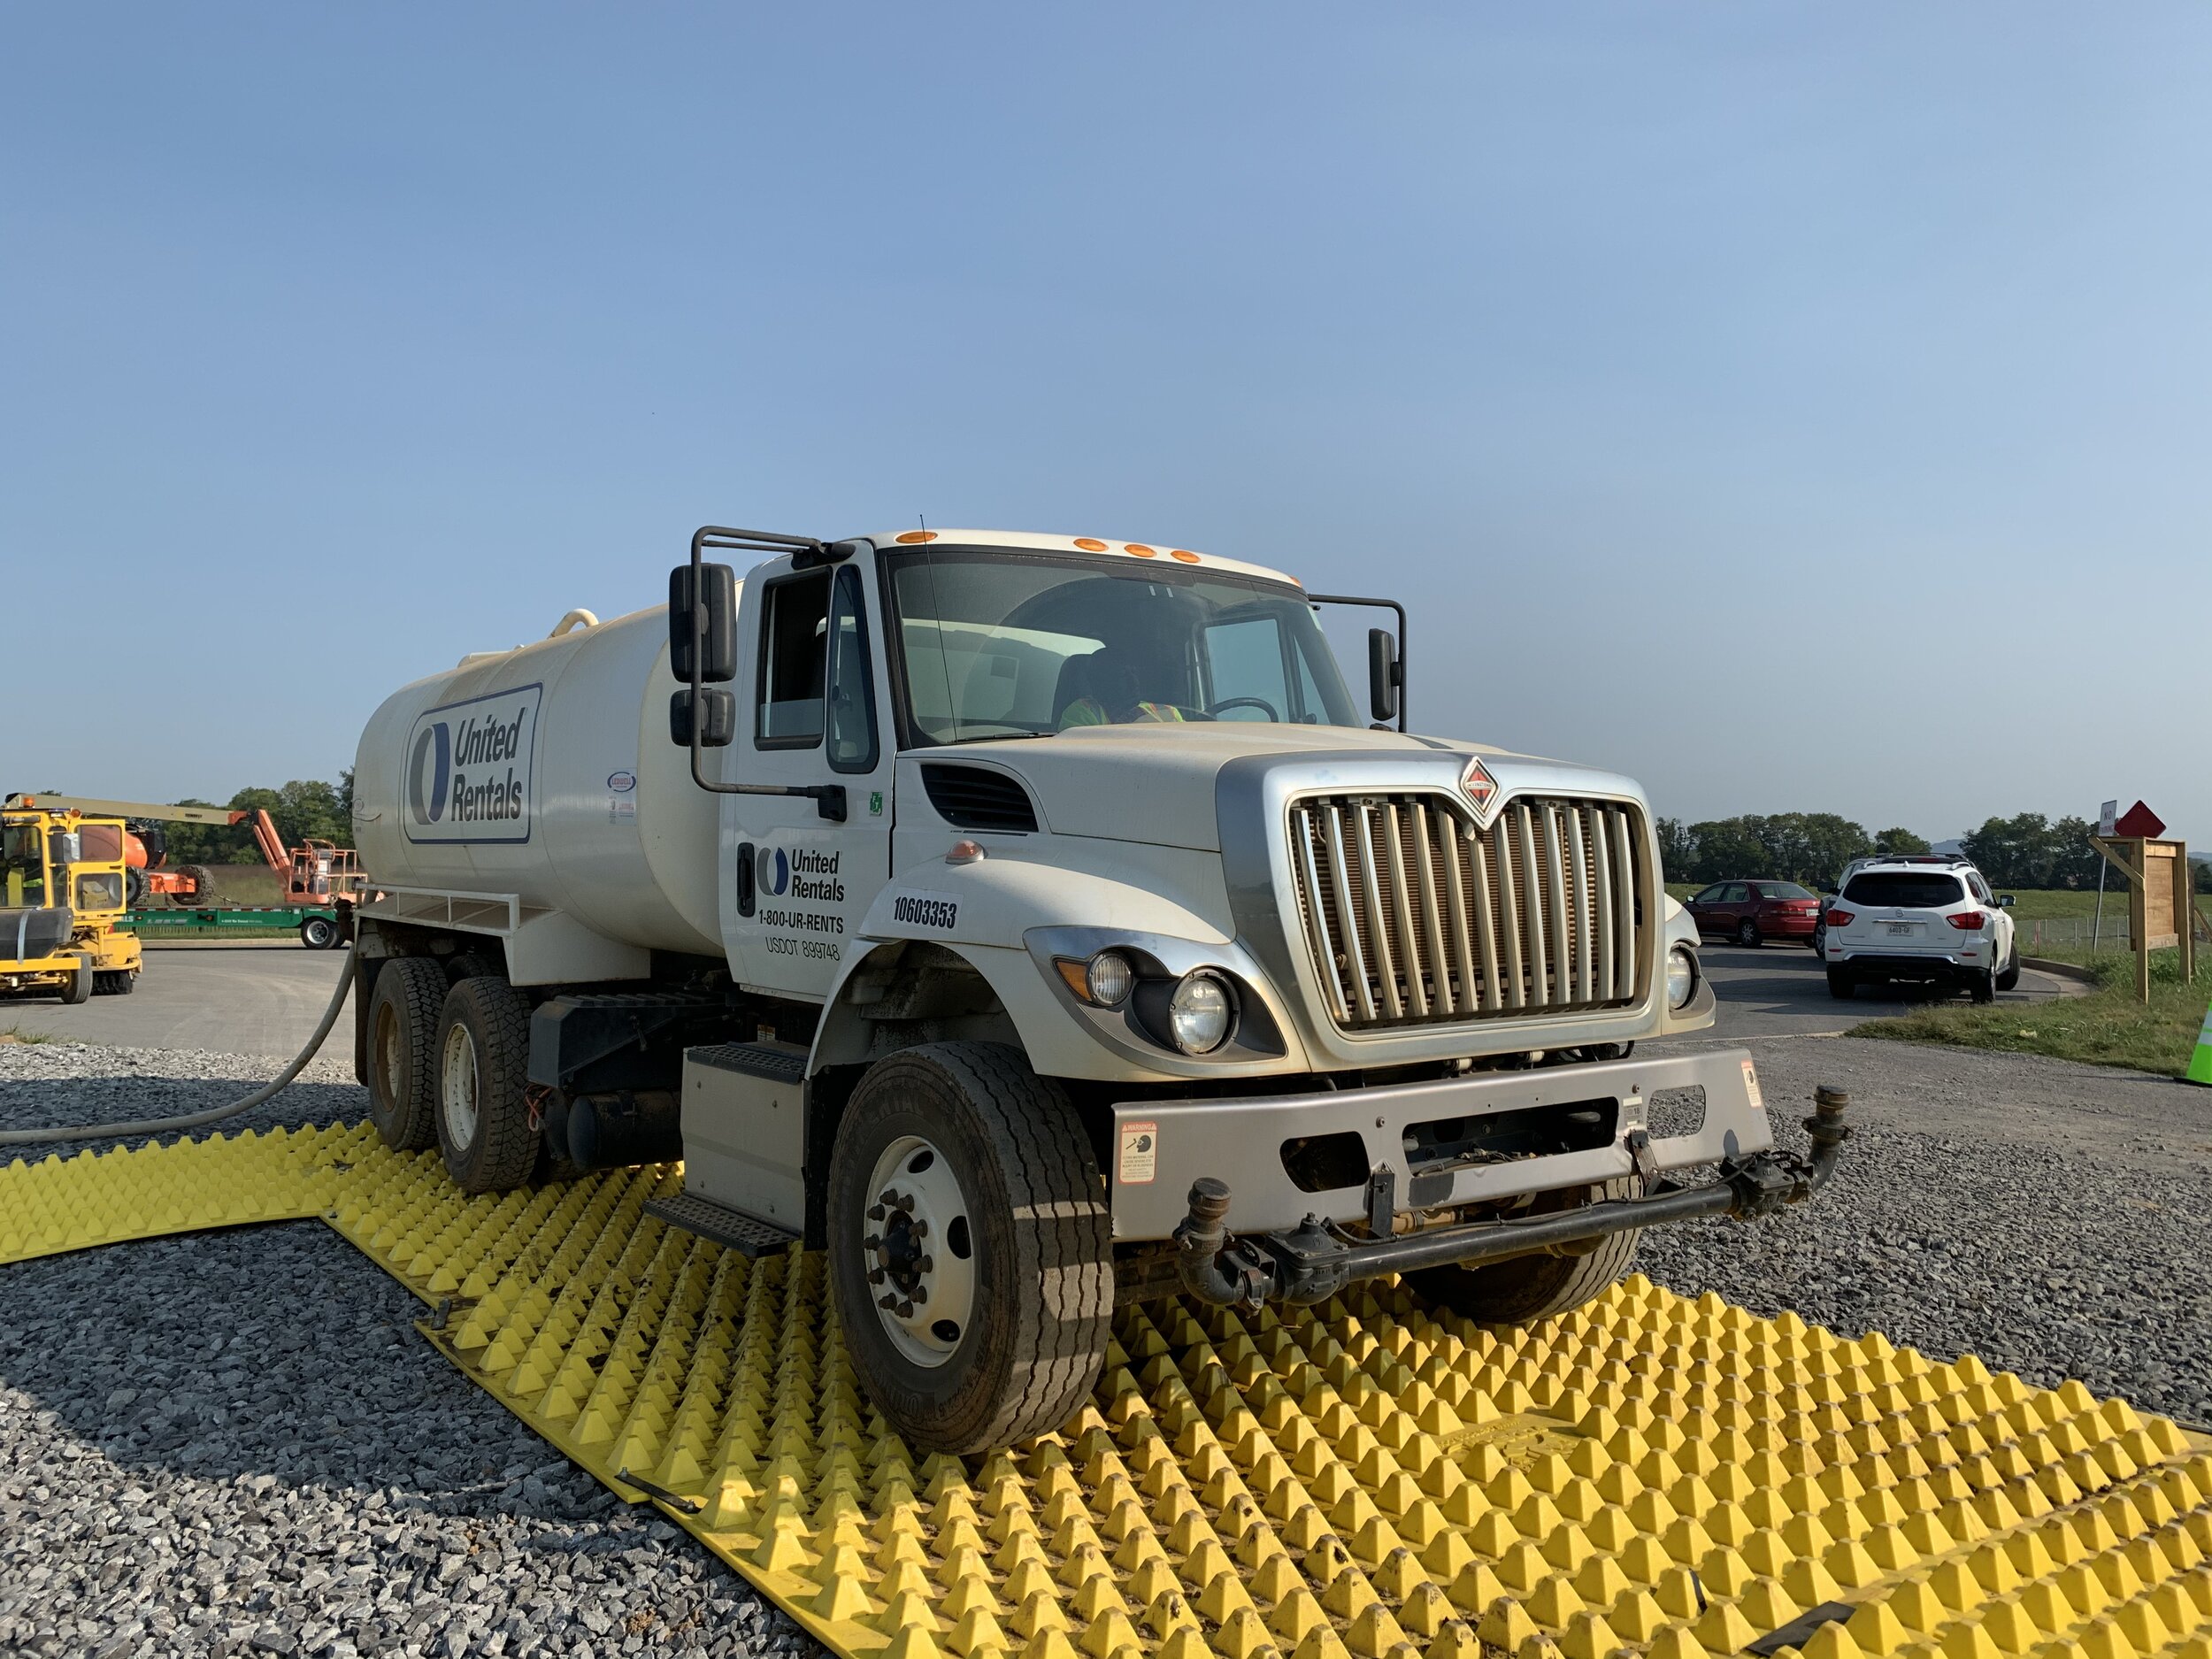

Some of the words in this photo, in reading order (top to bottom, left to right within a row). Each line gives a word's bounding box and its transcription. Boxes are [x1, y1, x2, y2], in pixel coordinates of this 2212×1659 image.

[455, 707, 526, 767] United
[451, 767, 522, 822] Rentals
[2103, 810, 2112, 821] NO
[791, 849, 840, 875] United
[791, 874, 845, 902] Rentals
[759, 909, 844, 934] 1-800-UR-RENTS
[894, 896, 957, 930] 10603353
[765, 936, 798, 956] USDOT
[802, 941, 841, 962] 899748
